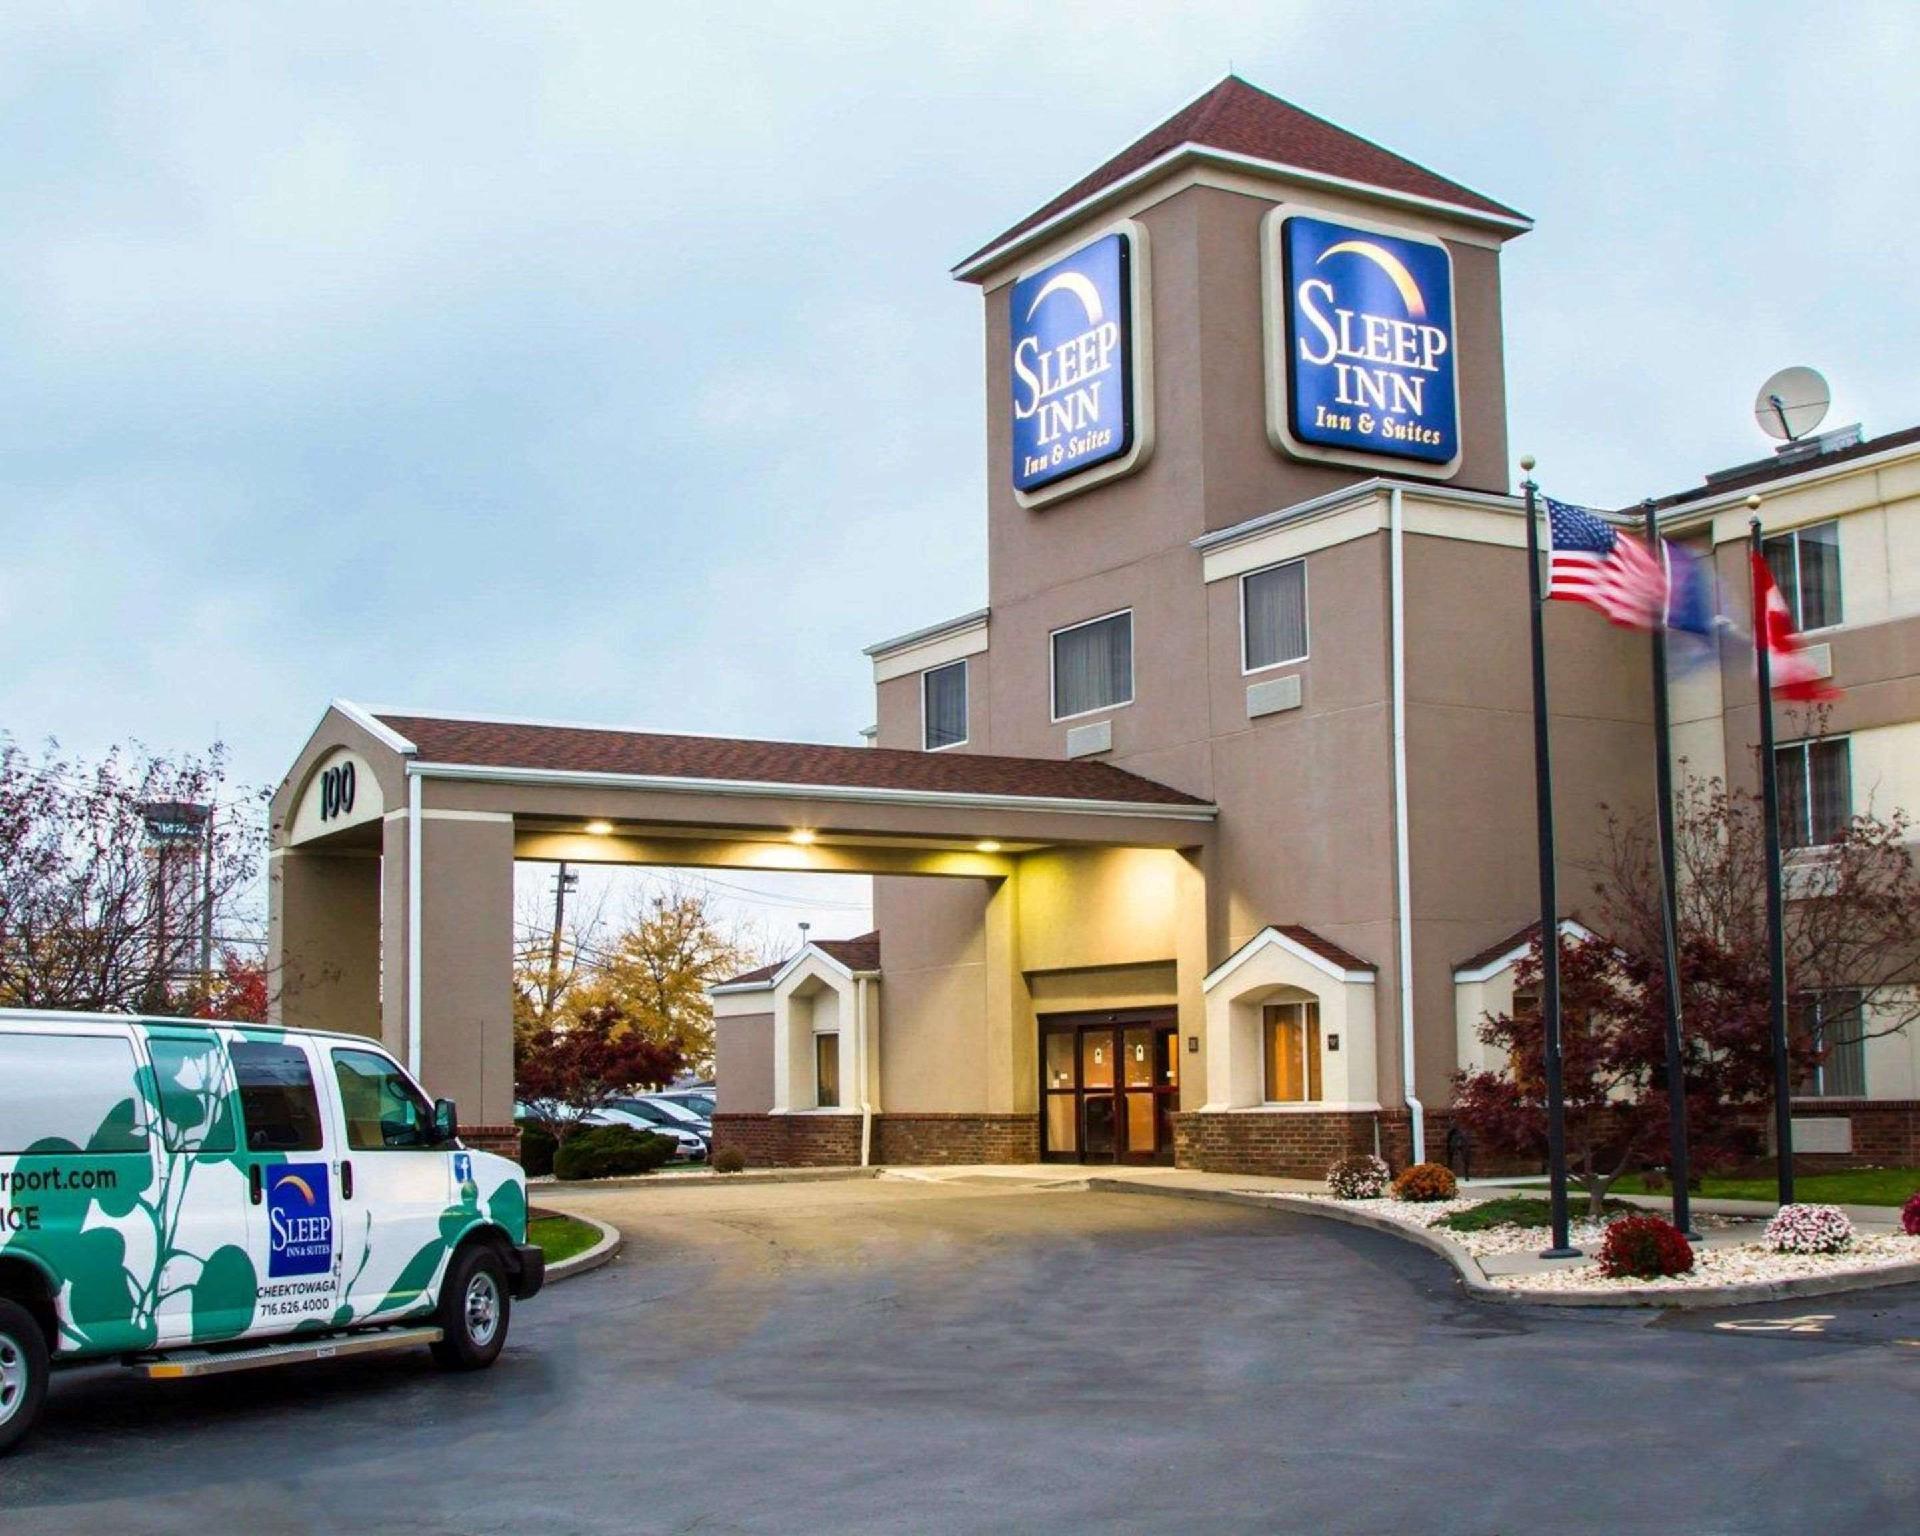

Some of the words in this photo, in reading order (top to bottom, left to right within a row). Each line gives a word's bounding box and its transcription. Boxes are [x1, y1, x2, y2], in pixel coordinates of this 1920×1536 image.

[1298, 279, 1448, 372] SLEEP
[1014, 322, 1118, 420] SLEEP
[1333, 362, 1426, 416] INN
[1037, 381, 1102, 446] INN
[1315, 405, 1352, 430] Inn
[1357, 412, 1376, 435] &
[1381, 416, 1442, 445] Suites
[1023, 455, 1048, 478] Inn
[1051, 443, 1064, 466] &
[1067, 427, 1112, 459] Suites
[320, 760, 356, 823] 100
[0, 1167, 117, 1197] rport.com
[0, 1206, 41, 1232] ICE
[270, 1206, 331, 1252] SLEEP
[286, 1246, 300, 1258] INN
[306, 1243, 331, 1257] SUITES
[257, 1280, 336, 1299] CHEEKTOWAGA
[260, 1298, 330, 1316] 716.626.4000
